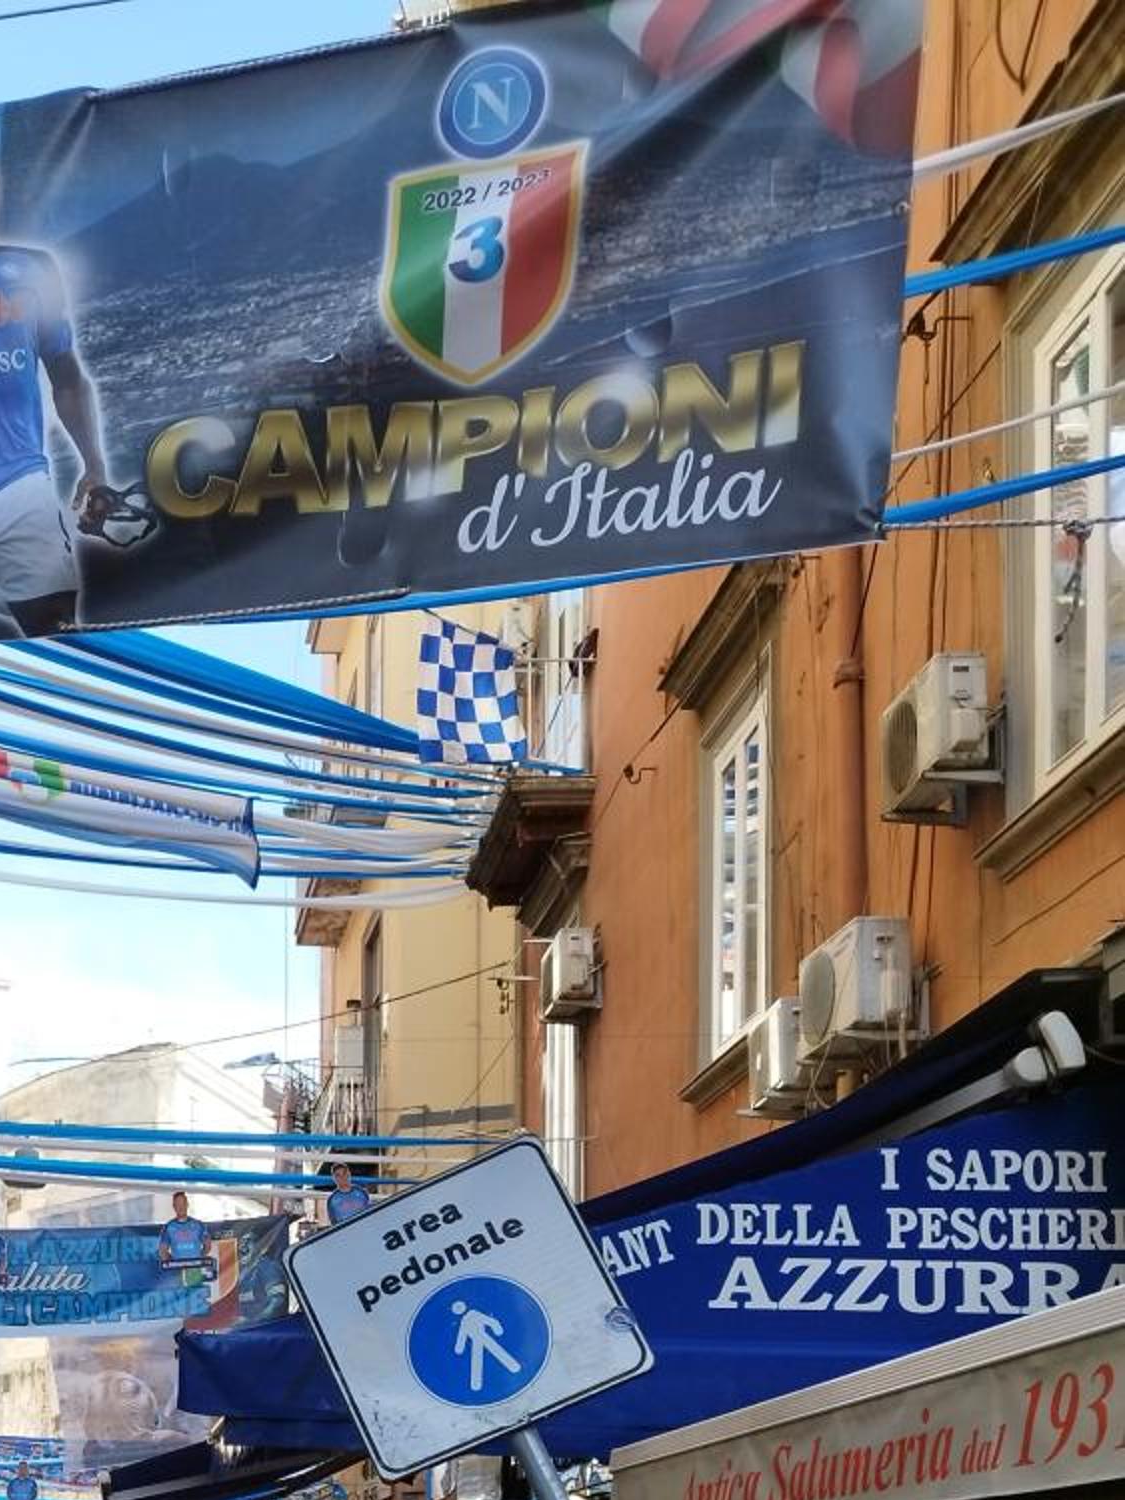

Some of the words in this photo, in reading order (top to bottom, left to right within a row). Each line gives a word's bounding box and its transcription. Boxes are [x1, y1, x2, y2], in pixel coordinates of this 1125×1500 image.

[467, 76, 517, 129] N
[424, 186, 476, 212] 2022
[498, 169, 551, 197] 2023
[448, 215, 506, 284] 3
[146, 341, 807, 519] CAMPIONI
[880, 1148, 900, 1191] I
[926, 1147, 1108, 1194] SAPORI
[381, 1202, 463, 1252] area
[696, 1203, 861, 1248] DELLA
[355, 1216, 525, 1312] pedonale
[960, 1422, 1007, 1478] dal
[1011, 1361, 1125, 1468] 193
